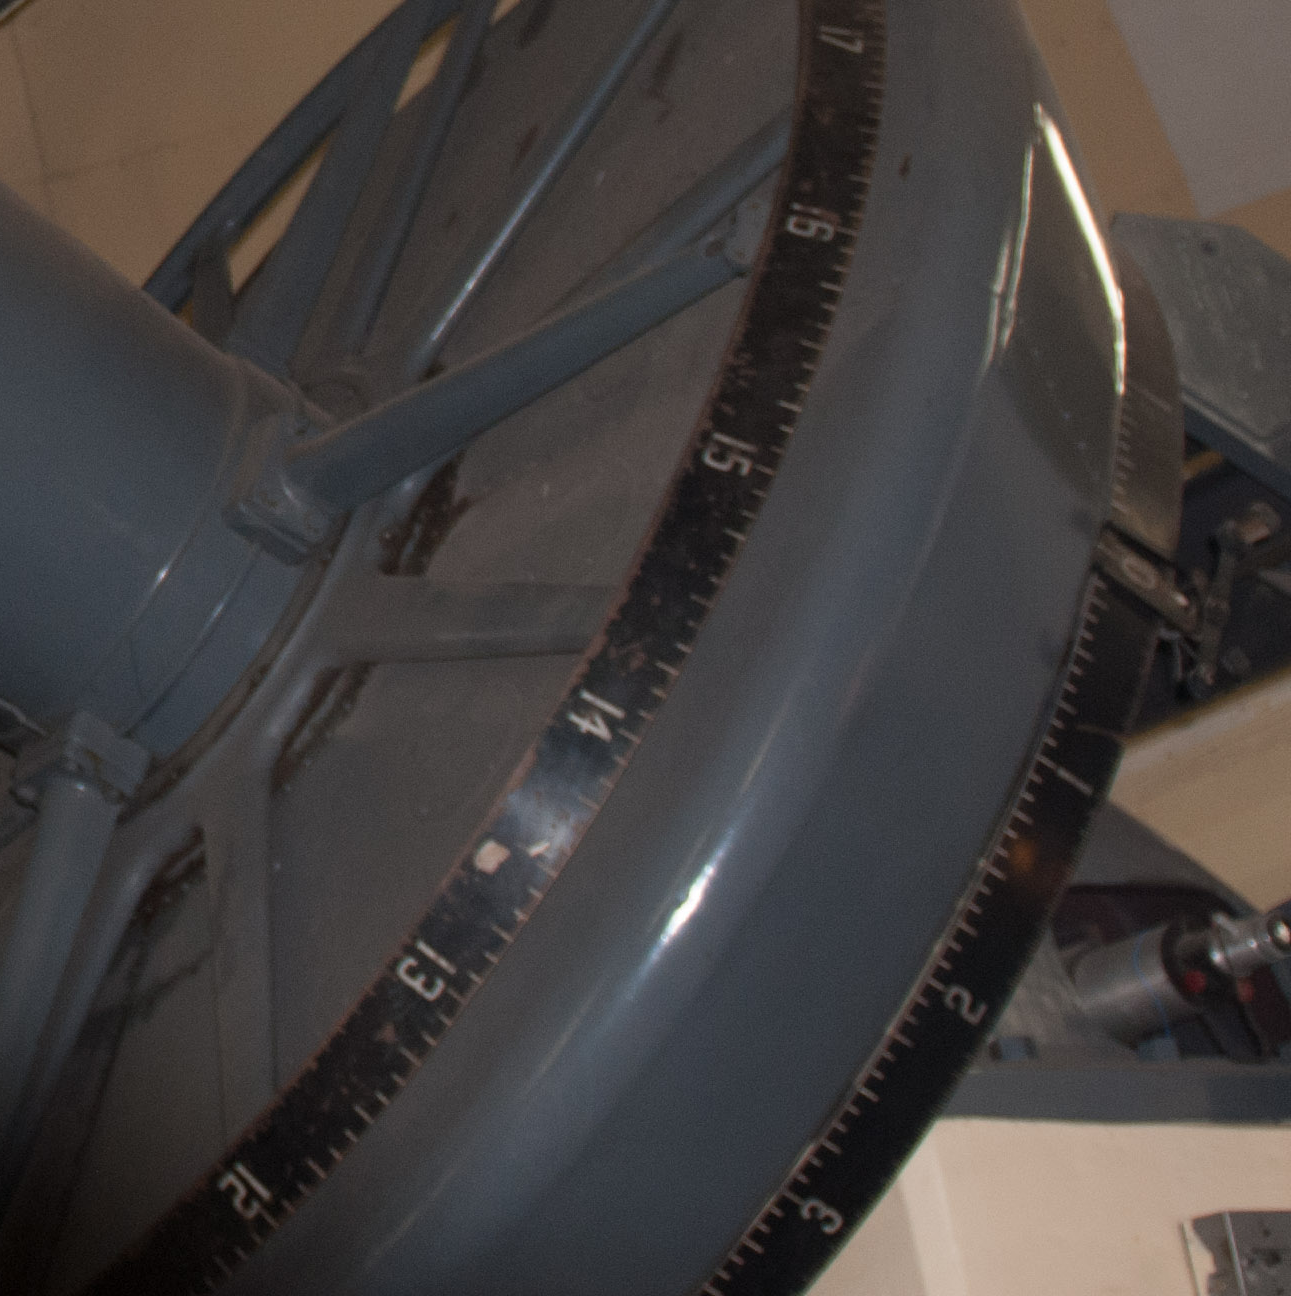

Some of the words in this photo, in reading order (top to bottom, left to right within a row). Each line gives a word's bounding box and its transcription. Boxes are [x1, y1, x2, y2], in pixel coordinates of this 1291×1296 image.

[785, 202, 836, 242] 16
[701, 431, 759, 477] 15
[566, 687, 626, 743] 14
[396, 938, 457, 1002] 13
[945, 984, 988, 1026] 2
[218, 1161, 272, 1221] 12
[799, 1197, 845, 1235] 3
